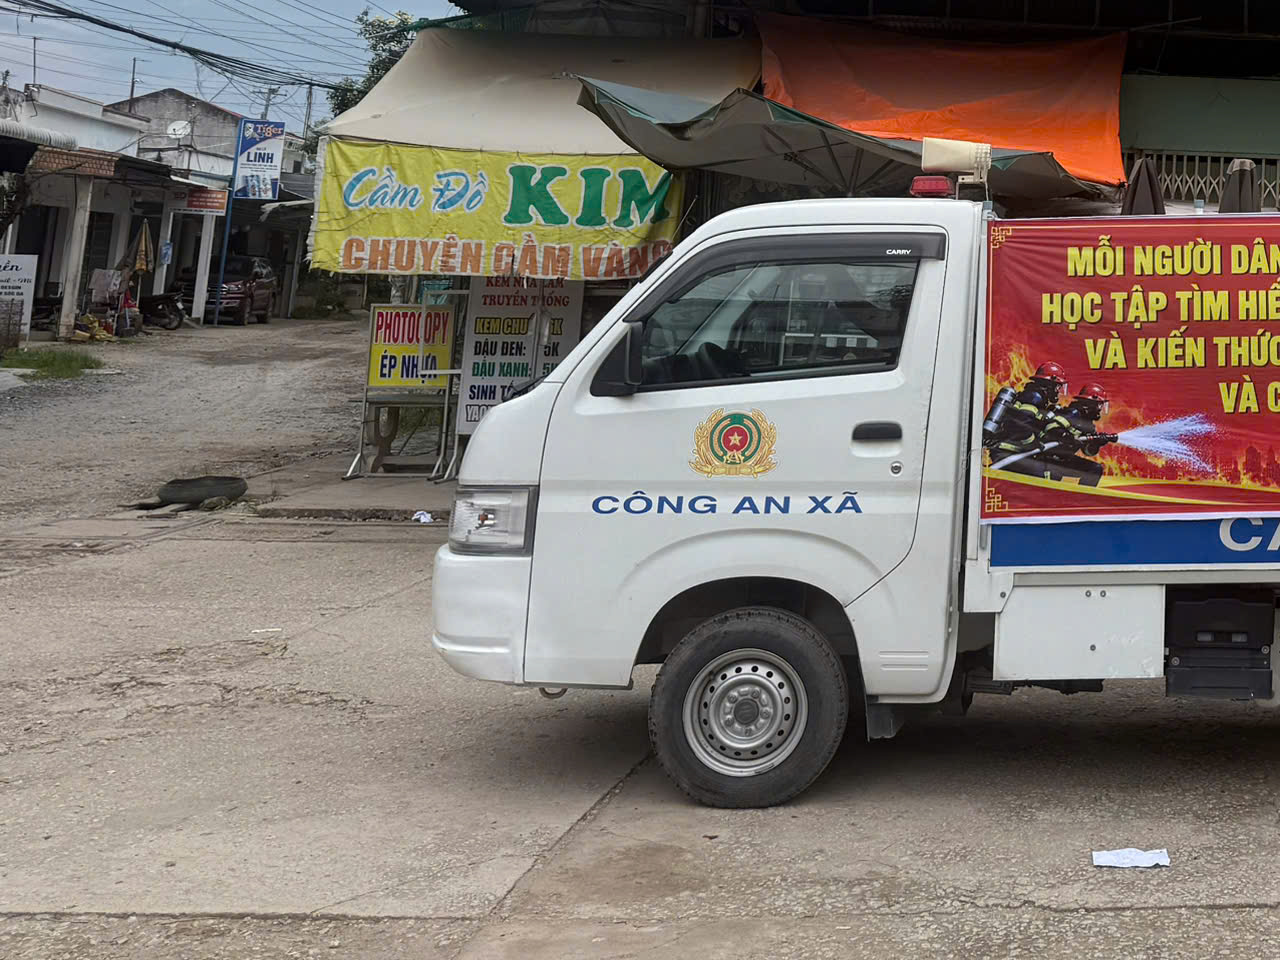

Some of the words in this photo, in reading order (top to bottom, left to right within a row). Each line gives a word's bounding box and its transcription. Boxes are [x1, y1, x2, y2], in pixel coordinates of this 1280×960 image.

[256, 123, 284, 136] Tiger
[246, 152, 275, 163] LINH
[343, 167, 423, 210] Cầm
[432, 171, 488, 212] Đồ
[503, 165, 674, 228] KIM
[341, 234, 484, 275] CHUYÊN
[492, 231, 573, 277] CẦM
[1067, 235, 1125, 277] MỖI
[1134, 238, 1222, 276] NGƯỜI
[1042, 292, 1102, 330] HỌC
[1111, 284, 1167, 329] TẬP
[1176, 283, 1230, 321] TÌM
[475, 317, 501, 334] KEM
[474, 338, 498, 358] ĐẬU
[544, 342, 560, 357] 5K
[1085, 331, 1127, 369] VÀ
[1137, 326, 1205, 368] KIẾN
[380, 349, 397, 378] ÉP
[472, 359, 496, 379] ĐẬU
[498, 362, 531, 377] XANH:
[469, 385, 497, 400] SINH
[1219, 375, 1259, 413] VÀ
[592, 490, 718, 515] CÔNG
[732, 496, 793, 515] AN
[805, 490, 864, 515] XÃ
